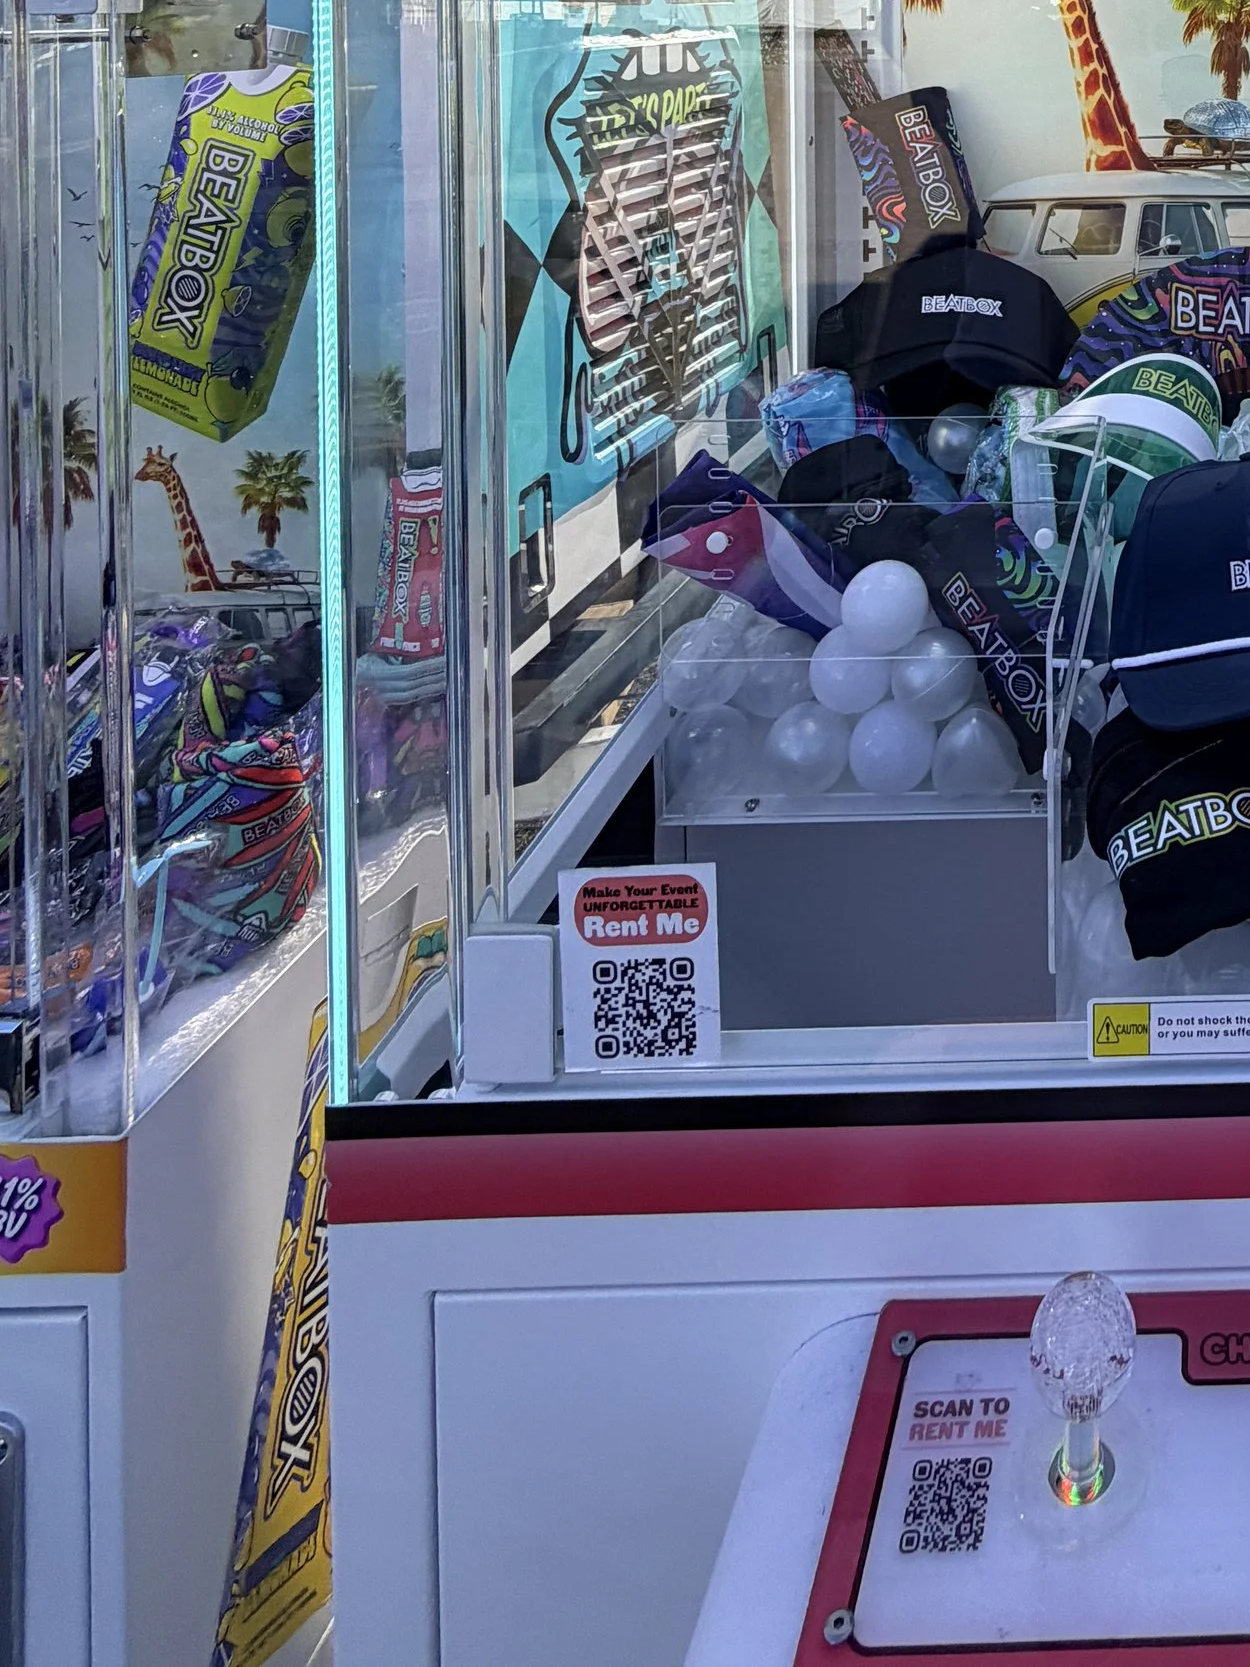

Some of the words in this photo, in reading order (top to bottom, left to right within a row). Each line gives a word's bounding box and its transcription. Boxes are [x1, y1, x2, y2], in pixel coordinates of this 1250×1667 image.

[211, 119, 225, 132] BY
[227, 122, 267, 143] VOLUME
[238, 114, 282, 135] ALCOHOL
[899, 107, 959, 225] BEATBOX
[160, 147, 248, 335] BEATBOX
[921, 293, 1004, 319] BEATBOX
[944, 575, 1050, 729] BEATBOX
[582, 885, 621, 899] Make
[624, 884, 657, 897] Your
[660, 882, 699, 896] Event
[582, 898, 700, 913] UNFORGETTABLE
[583, 913, 649, 939] Rent
[656, 912, 700, 935] Me
[1117, 1023, 1149, 1034] CAUTION
[1157, 1016, 1172, 1026] Do
[1176, 1016, 1195, 1026] not
[1198, 1015, 1233, 1025] shock
[1157, 1030, 1169, 1039] or
[1172, 1029, 1193, 1041] you
[1196, 1028, 1220, 1040] may
[913, 1398, 974, 1419] SCAN
[980, 1396, 1010, 1416] TO
[908, 1420, 971, 1442] RENT
[974, 1418, 1009, 1439] ME
